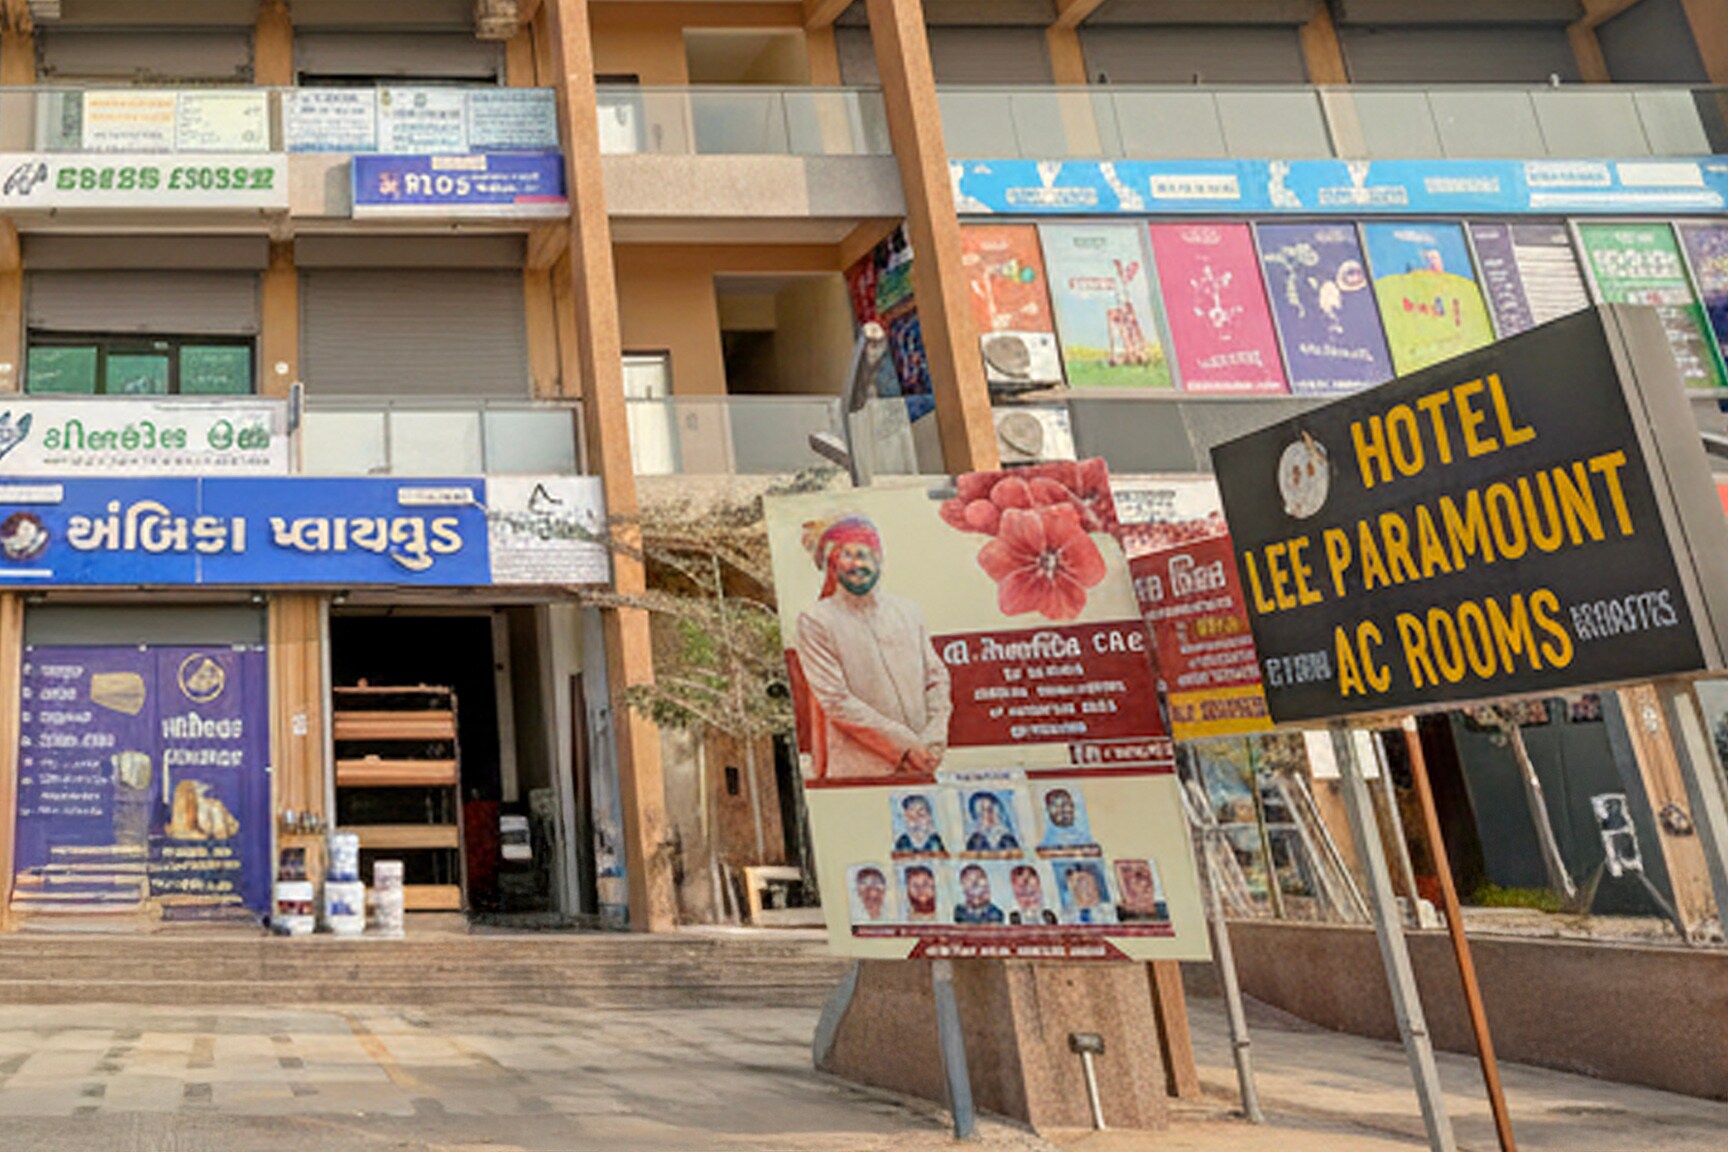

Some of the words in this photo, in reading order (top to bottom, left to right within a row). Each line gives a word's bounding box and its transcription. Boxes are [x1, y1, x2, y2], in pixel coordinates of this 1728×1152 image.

[1350, 373, 1536, 488] HOTEL
[1245, 536, 1323, 615] LEE
[1324, 450, 1635, 599] PARAMOUNT
[1335, 621, 1392, 697] AC
[1396, 589, 1574, 689] ROOMS
